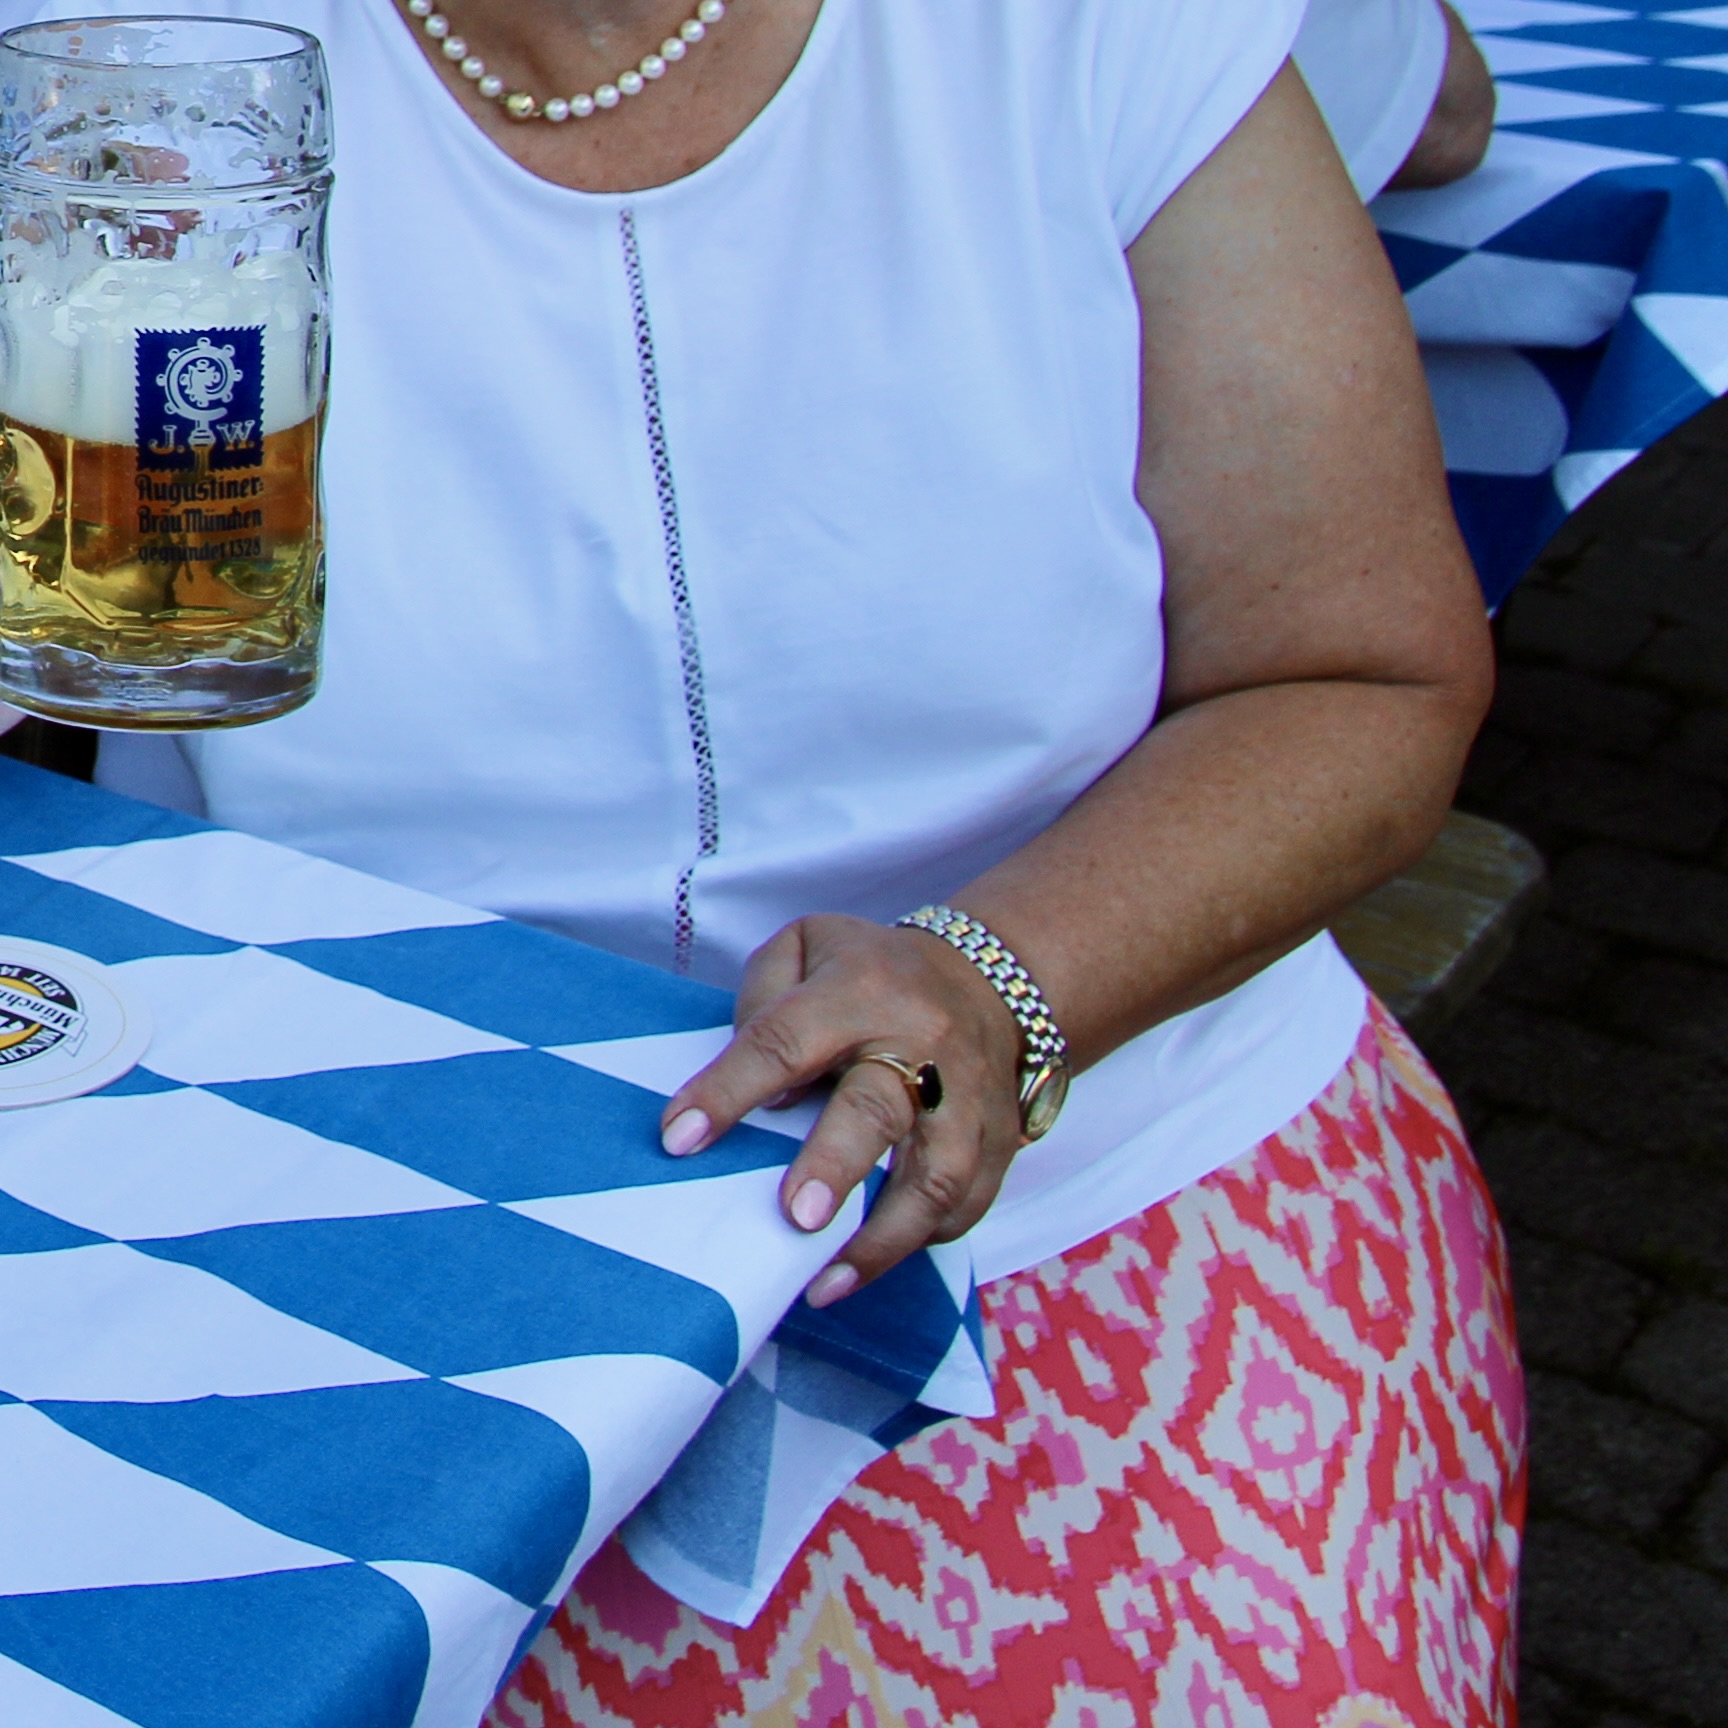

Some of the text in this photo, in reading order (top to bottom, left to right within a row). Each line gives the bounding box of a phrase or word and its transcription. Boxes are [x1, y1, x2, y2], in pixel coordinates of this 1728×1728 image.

[148, 419, 256, 455] J. W.
[137, 505, 263, 534] Bräu München
[228, 535, 262, 559] 1328
